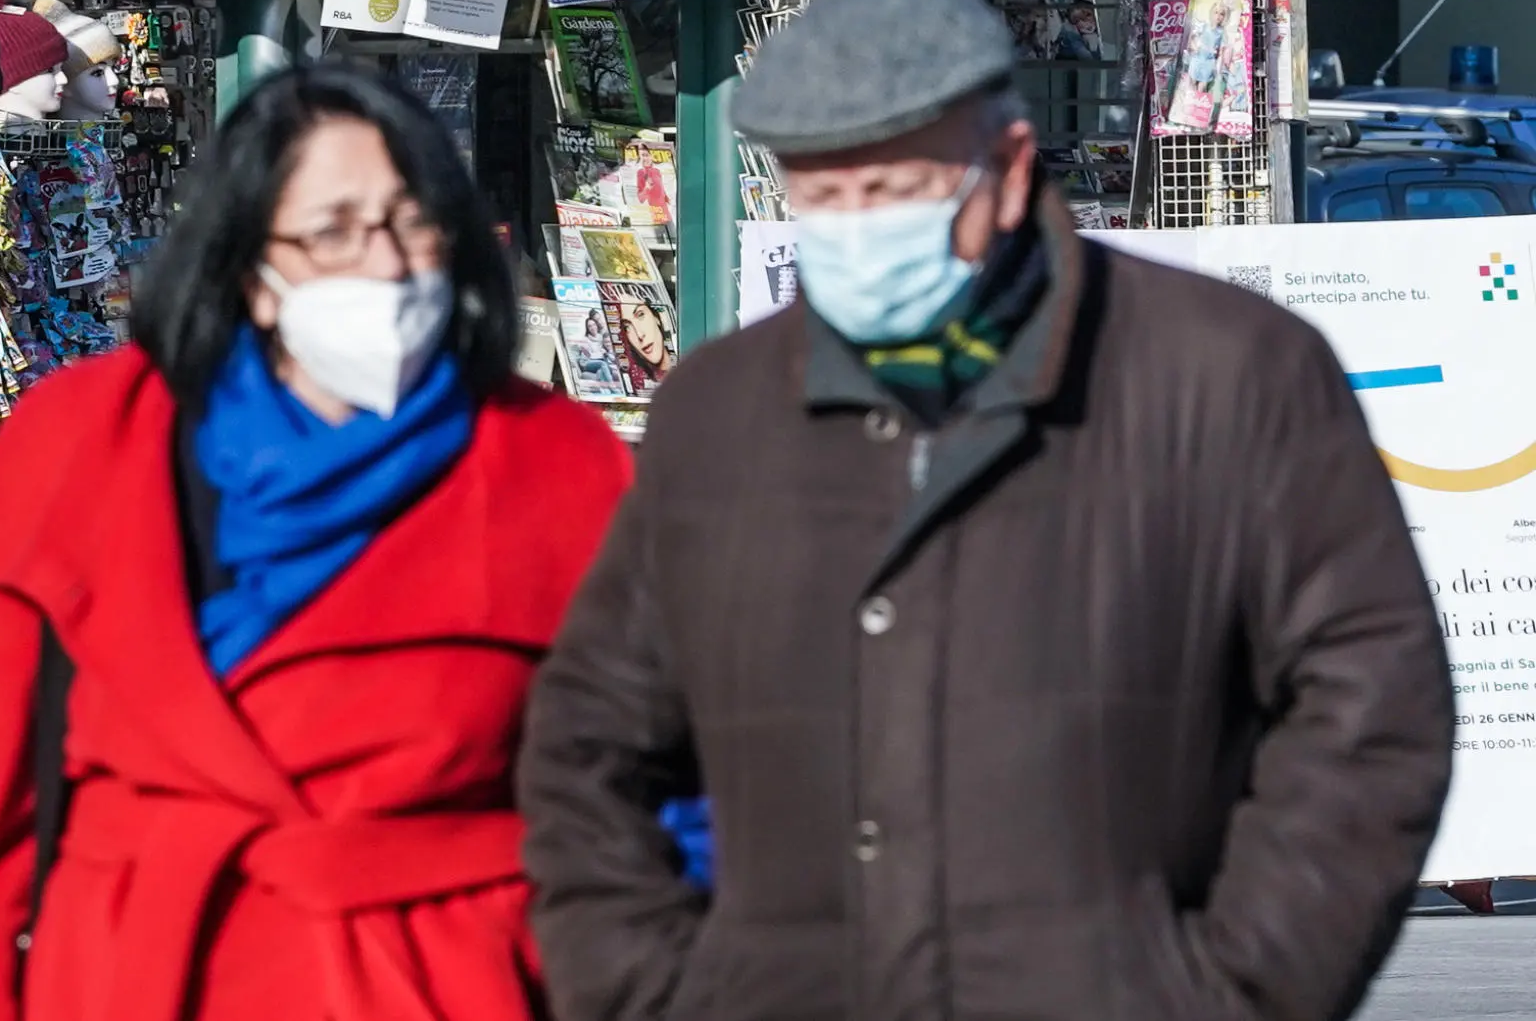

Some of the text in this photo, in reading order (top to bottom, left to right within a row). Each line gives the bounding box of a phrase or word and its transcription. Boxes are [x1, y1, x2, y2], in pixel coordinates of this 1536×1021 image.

[1284, 271, 1370, 286] Sei invitato,
[1286, 288, 1431, 307] partecipa anche tu.
[1452, 568, 1492, 595] dei
[1472, 611, 1496, 637] ai
[1500, 658, 1514, 670] di
[1452, 681, 1529, 696] per il bene
[1479, 713, 1494, 724] 26
